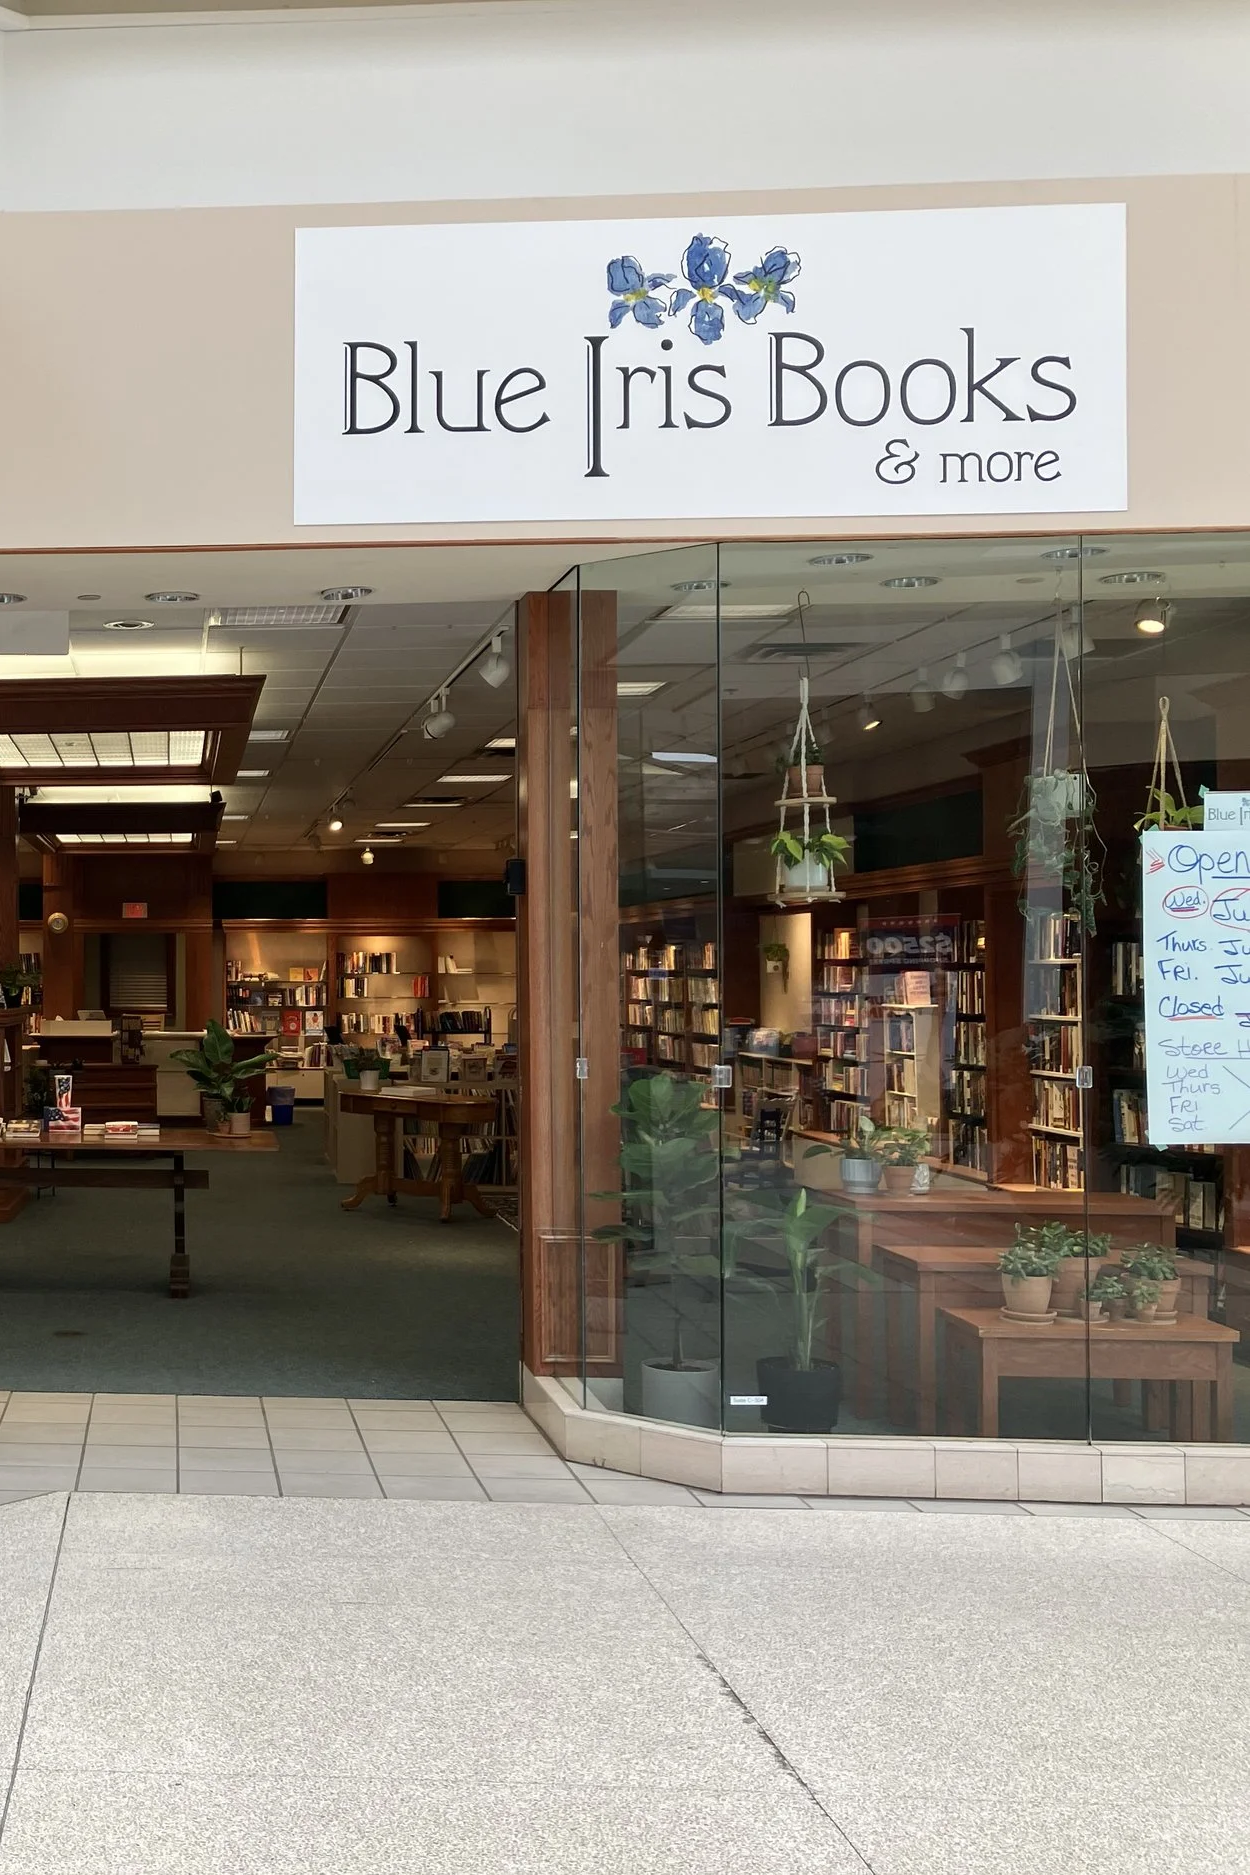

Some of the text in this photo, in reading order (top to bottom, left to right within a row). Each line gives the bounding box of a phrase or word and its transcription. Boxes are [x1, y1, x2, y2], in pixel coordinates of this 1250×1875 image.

[342, 327, 1078, 478] Blue Iris Books
[875, 439, 1063, 486] & more
[1207, 807, 1236, 821] Blue
[1158, 994, 1225, 1018] Closed
[1166, 1063, 1209, 1080] Wed
[1161, 1080, 1221, 1095] Thurs
